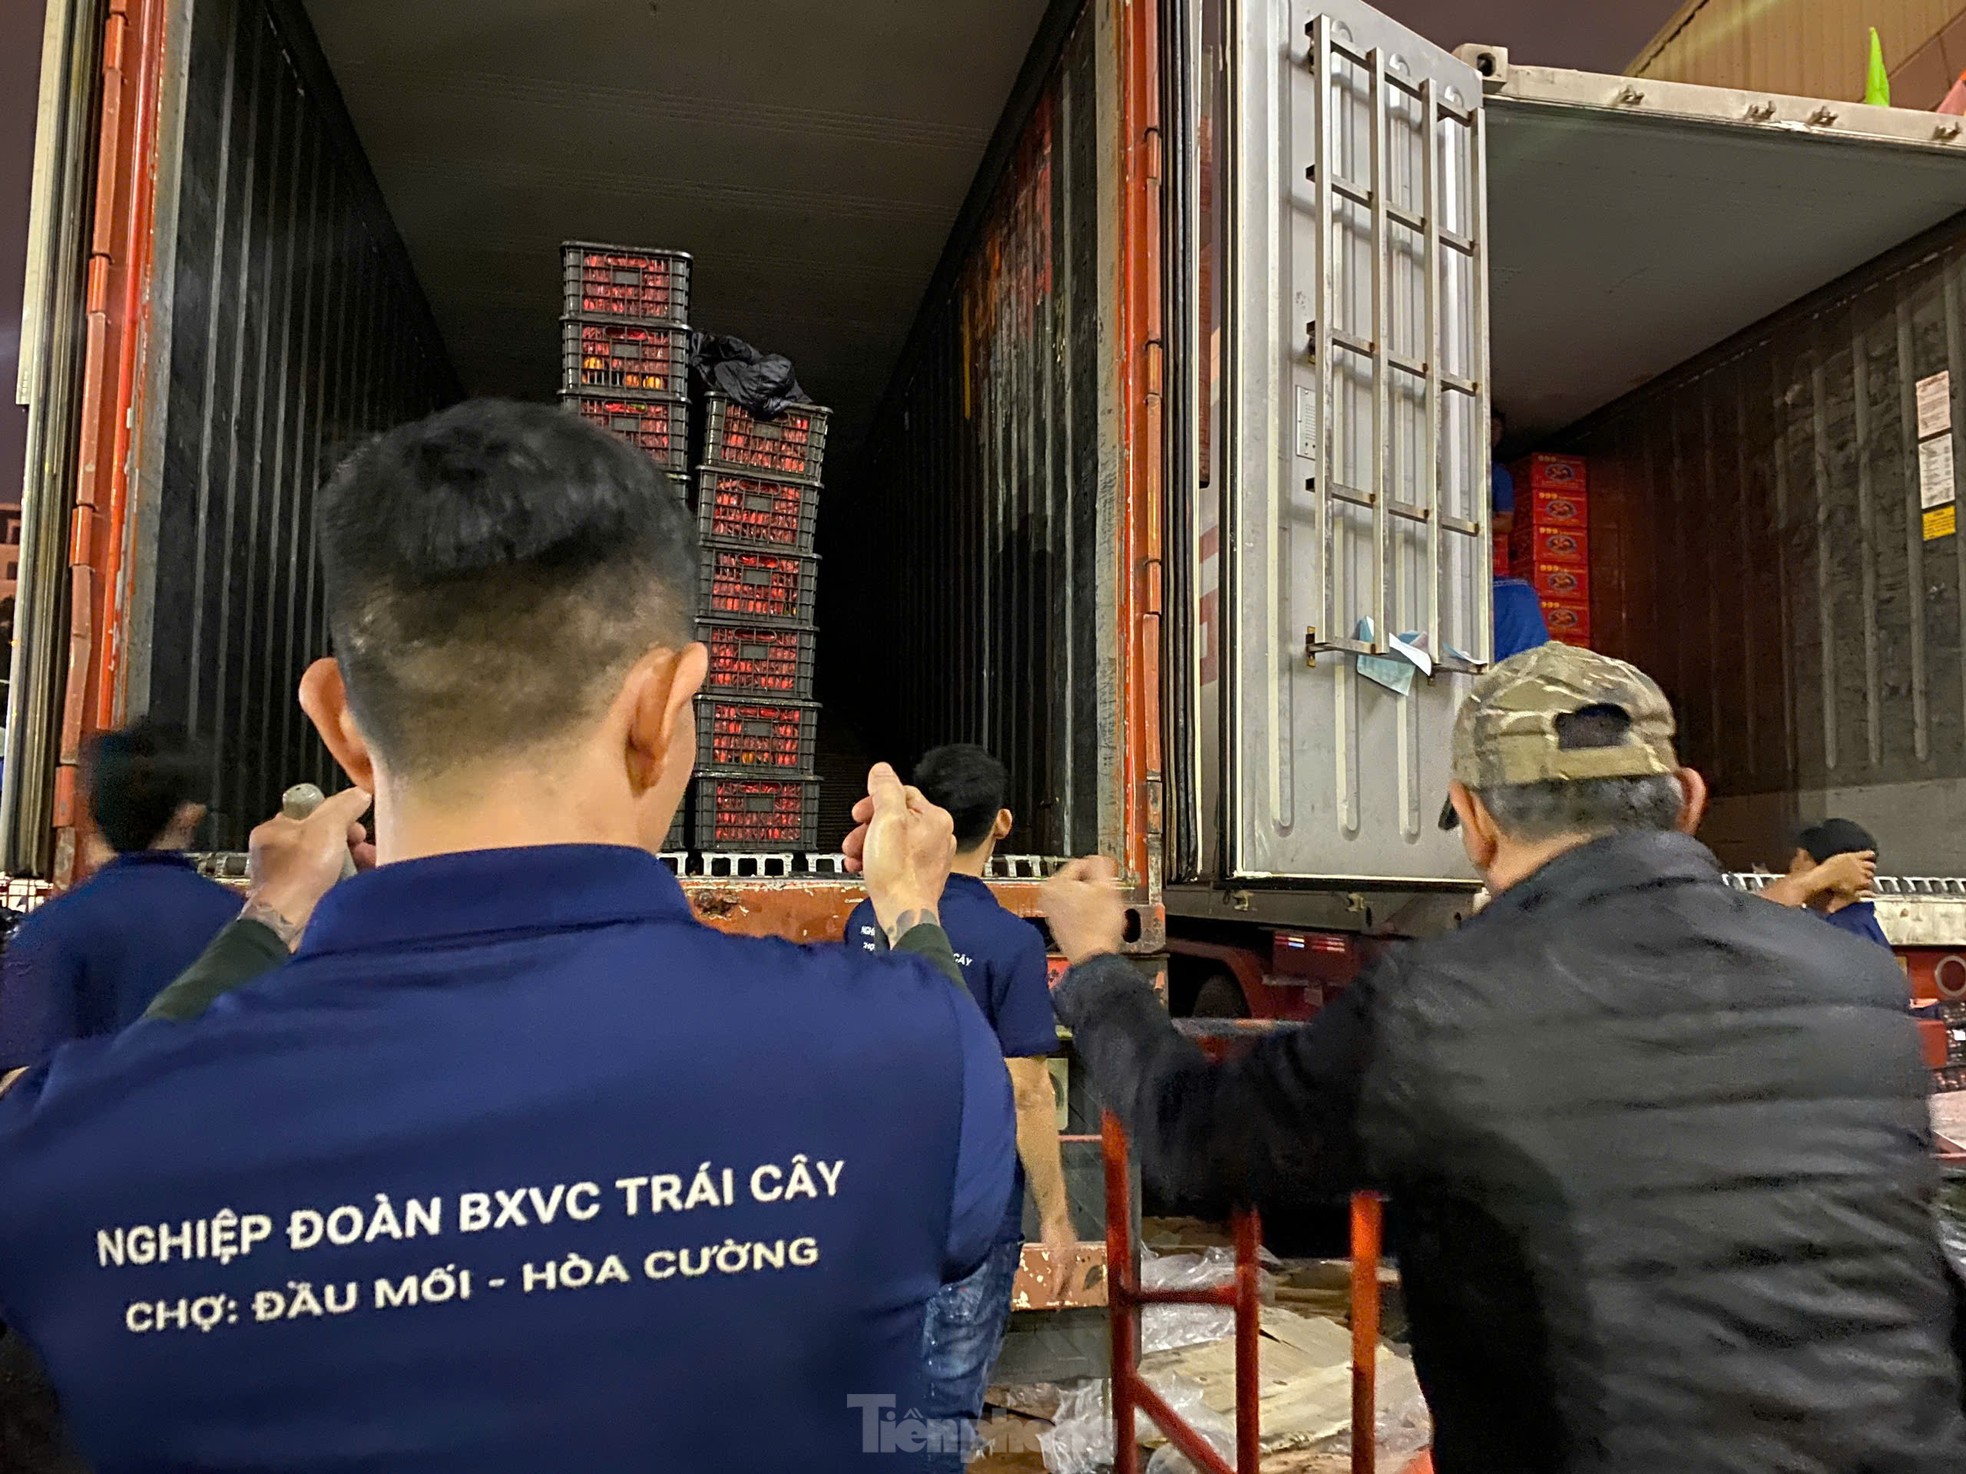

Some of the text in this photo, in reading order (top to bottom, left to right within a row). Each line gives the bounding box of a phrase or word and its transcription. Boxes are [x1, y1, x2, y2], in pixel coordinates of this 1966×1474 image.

[97, 1153, 845, 1267] NGHIỆP ĐOÀN BXVC TRÁI CÂY
[125, 1236, 819, 1332] CHỢ: ĐẦU MỐI - HÒA CƯỜNG
